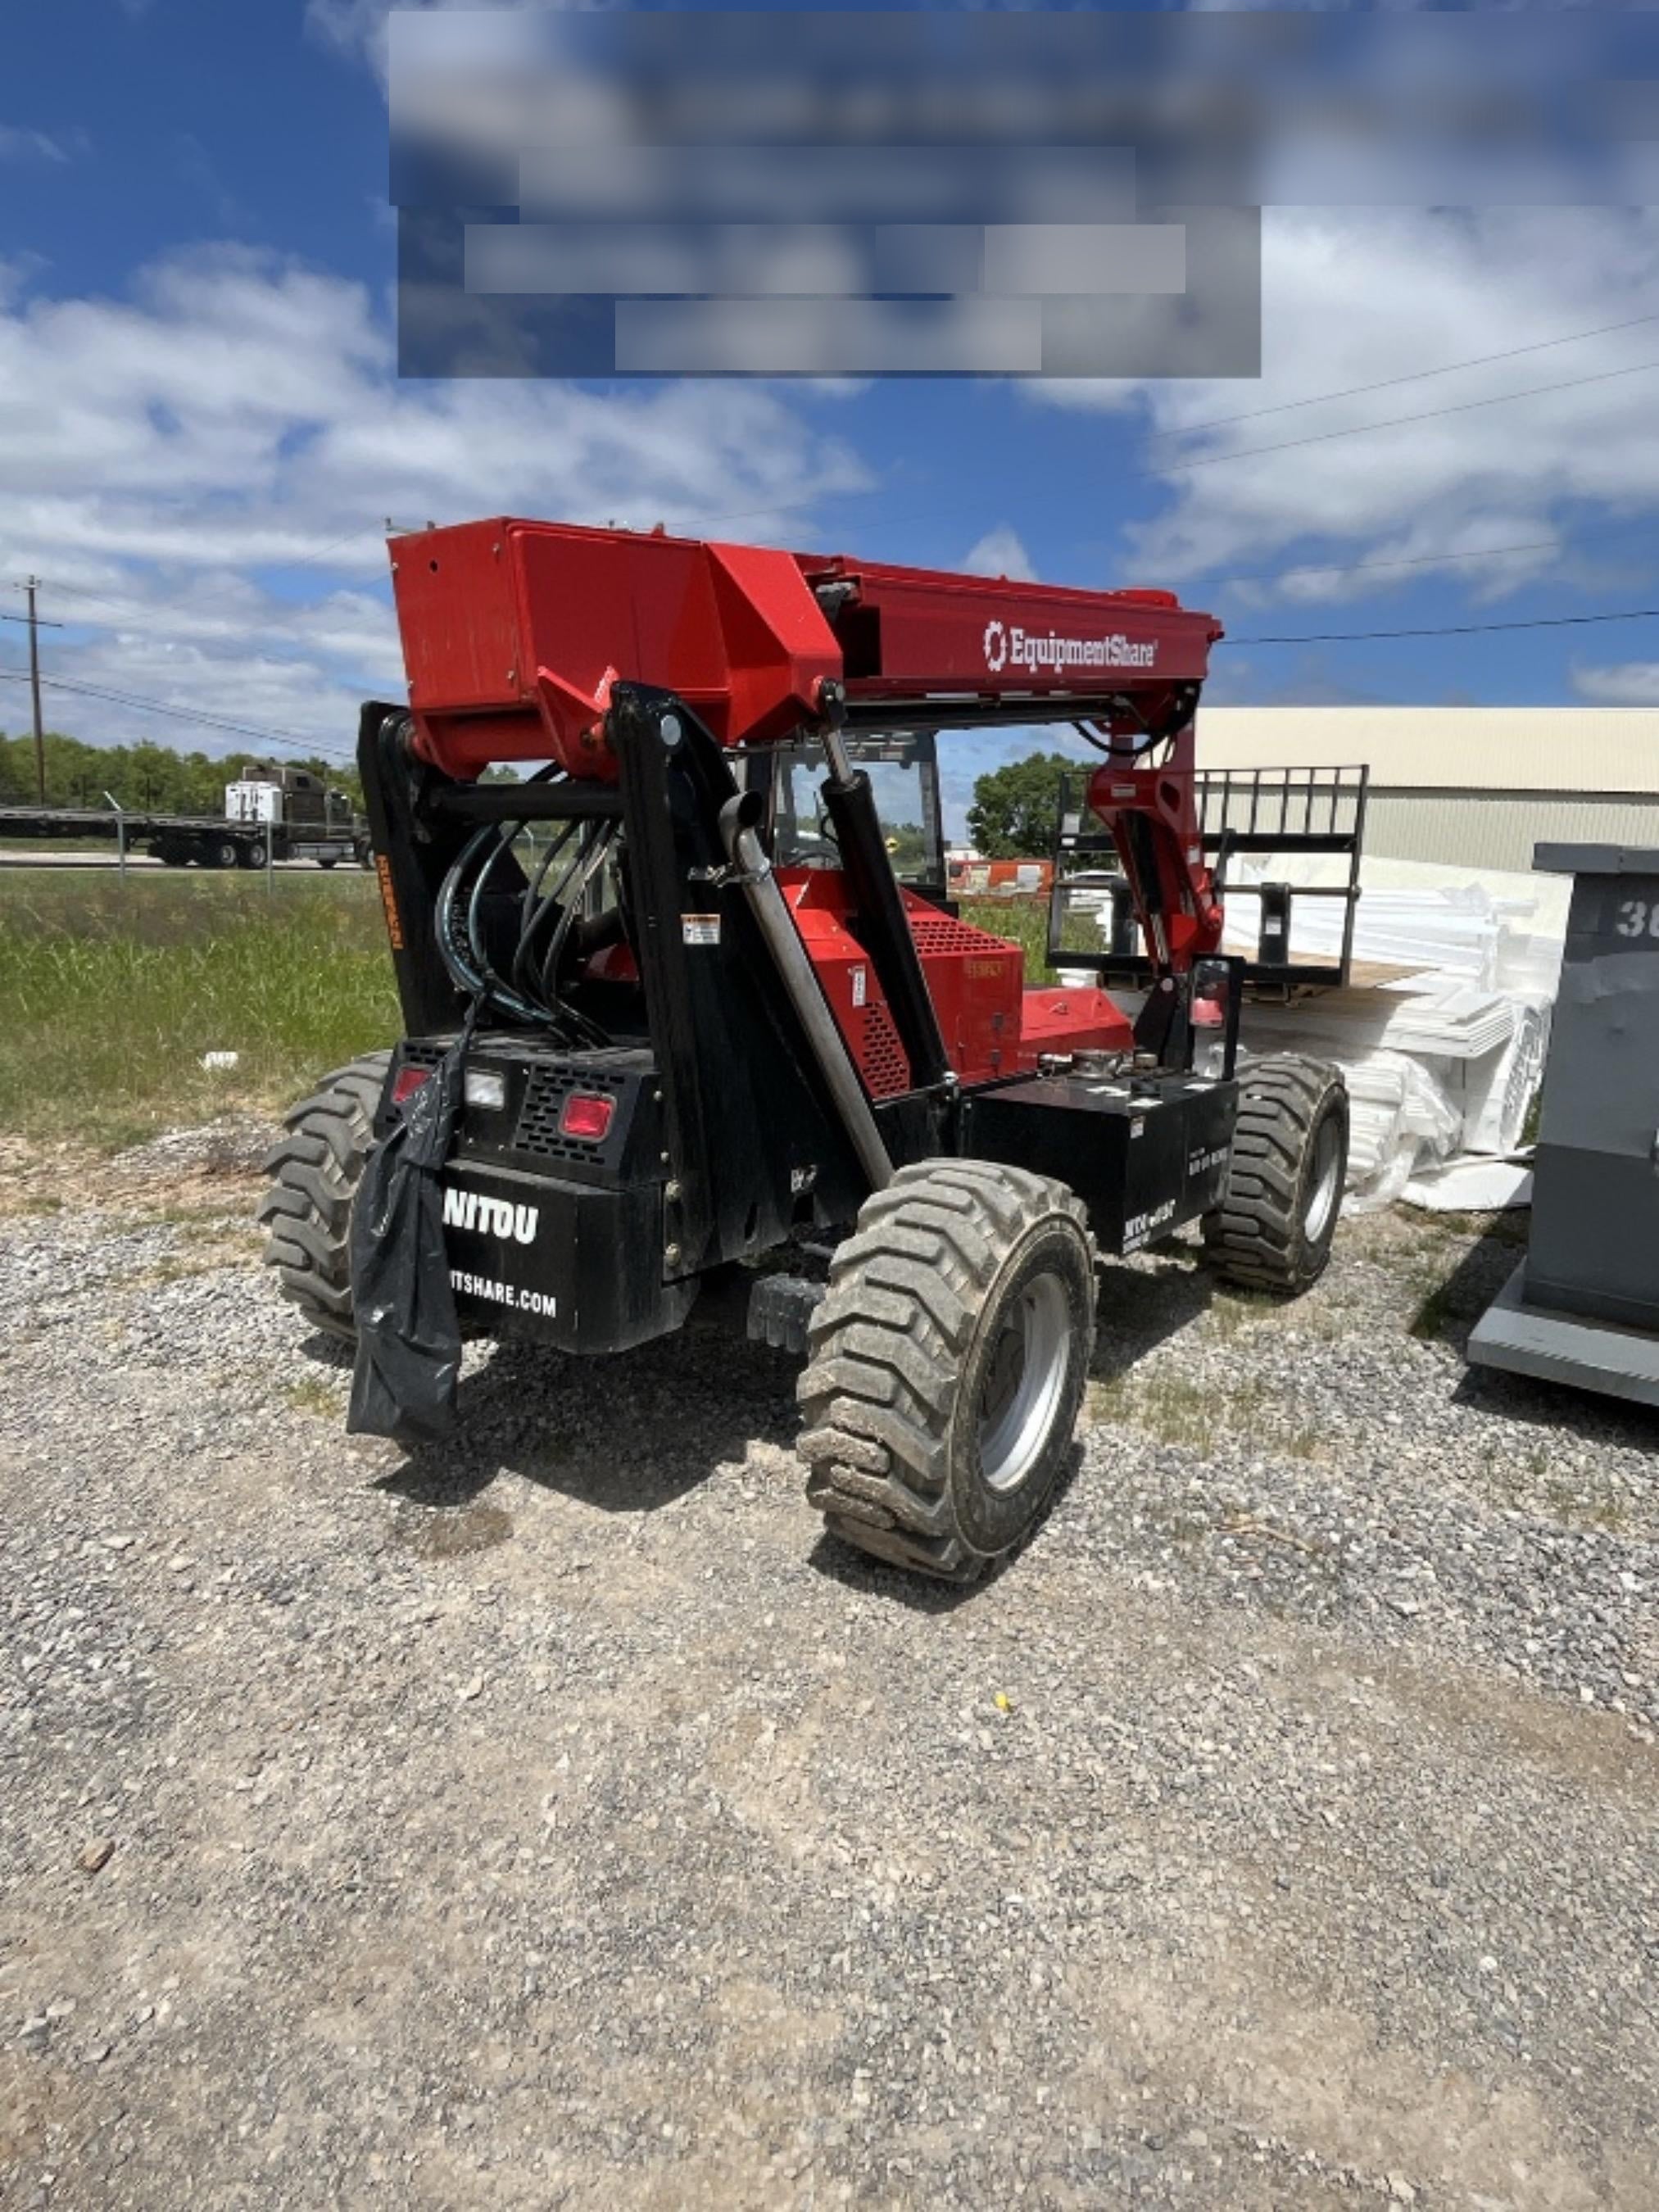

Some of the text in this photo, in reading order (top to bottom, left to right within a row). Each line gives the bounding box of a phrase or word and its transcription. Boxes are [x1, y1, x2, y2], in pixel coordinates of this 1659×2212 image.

[1009, 626, 1154, 674] EquipmentShare
[442, 1187, 538, 1244] NITOU
[451, 1270, 556, 1318] TSHARE.COM
